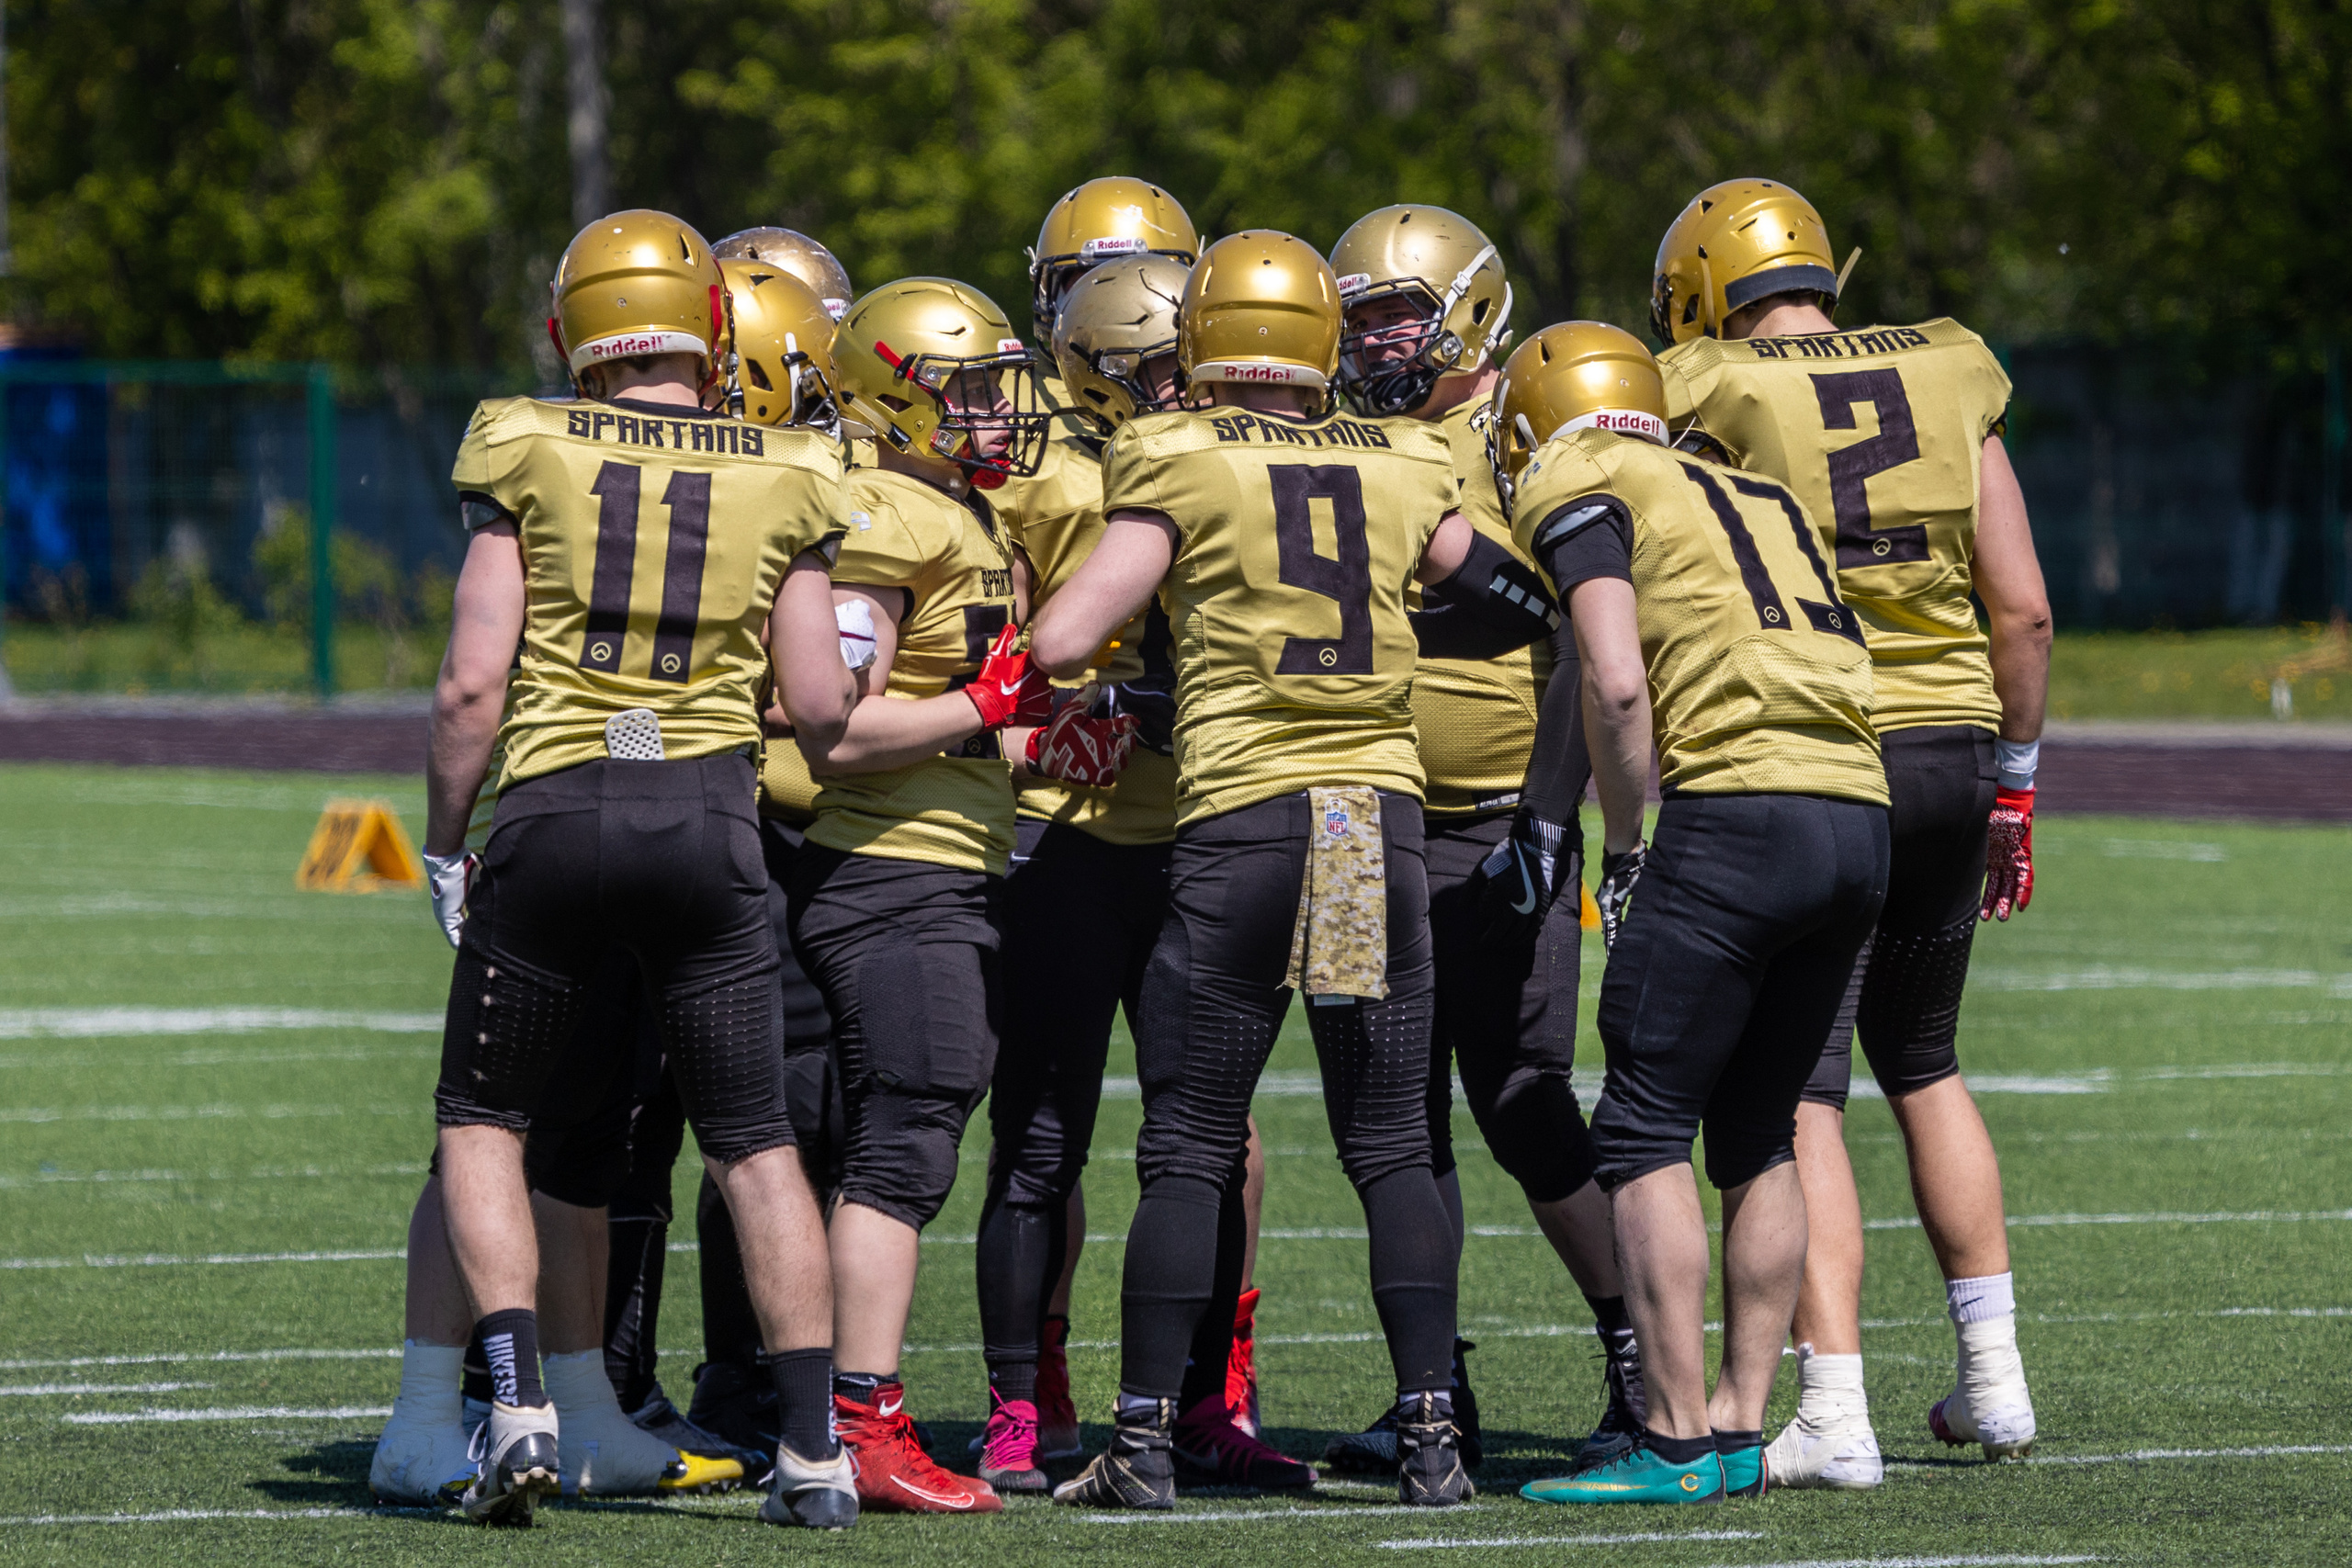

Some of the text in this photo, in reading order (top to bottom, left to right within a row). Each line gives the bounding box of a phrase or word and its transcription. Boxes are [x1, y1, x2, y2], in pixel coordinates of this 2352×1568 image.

[1098, 240, 1132, 250] Riddell
[568, 410, 763, 457] SPARTANS
[1212, 414, 1392, 449] SPARTANS
[1596, 413, 1659, 436] Riddell
[1808, 367, 1931, 570] 2
[579, 460, 711, 683] 11
[1266, 464, 1374, 675] 9
[1329, 821, 1346, 833] NFL
